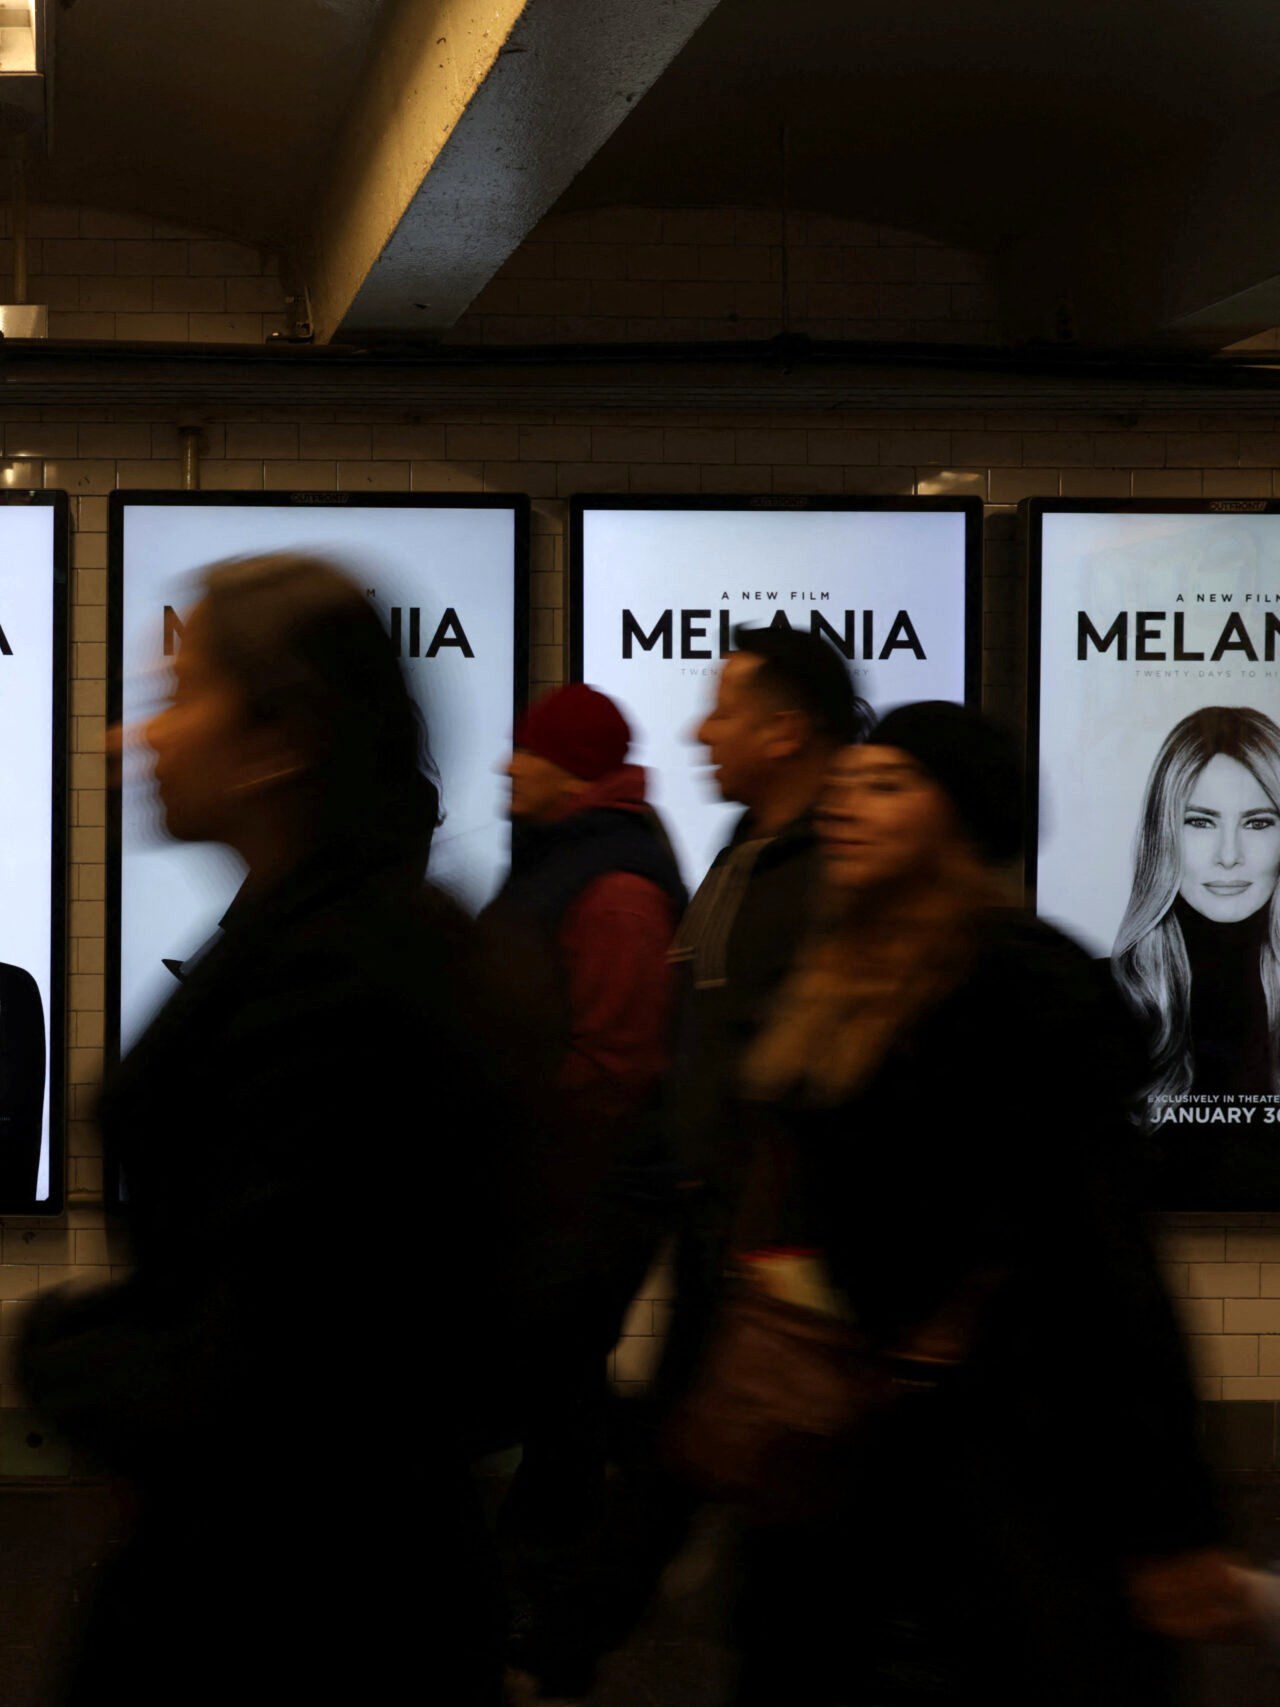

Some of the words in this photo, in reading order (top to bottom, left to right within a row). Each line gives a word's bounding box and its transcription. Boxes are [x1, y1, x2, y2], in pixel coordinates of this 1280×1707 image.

[721, 591, 730, 601] A
[742, 591, 778, 601] NEW
[790, 591, 830, 601] FILM
[1175, 593, 1185, 603] A
[1196, 593, 1233, 603] NEW
[1077, 610, 1280, 662] MELA
[1135, 670, 1190, 679] TWENTY
[1198, 670, 1232, 679] DAYS
[1240, 670, 1257, 679] TO
[1148, 1094, 1219, 1103] EXCLUSIVELY
[1223, 1094, 1235, 1103] IN
[1238, 1094, 1280, 1103] THEATE
[1150, 1107, 1256, 1124] JANUARY
